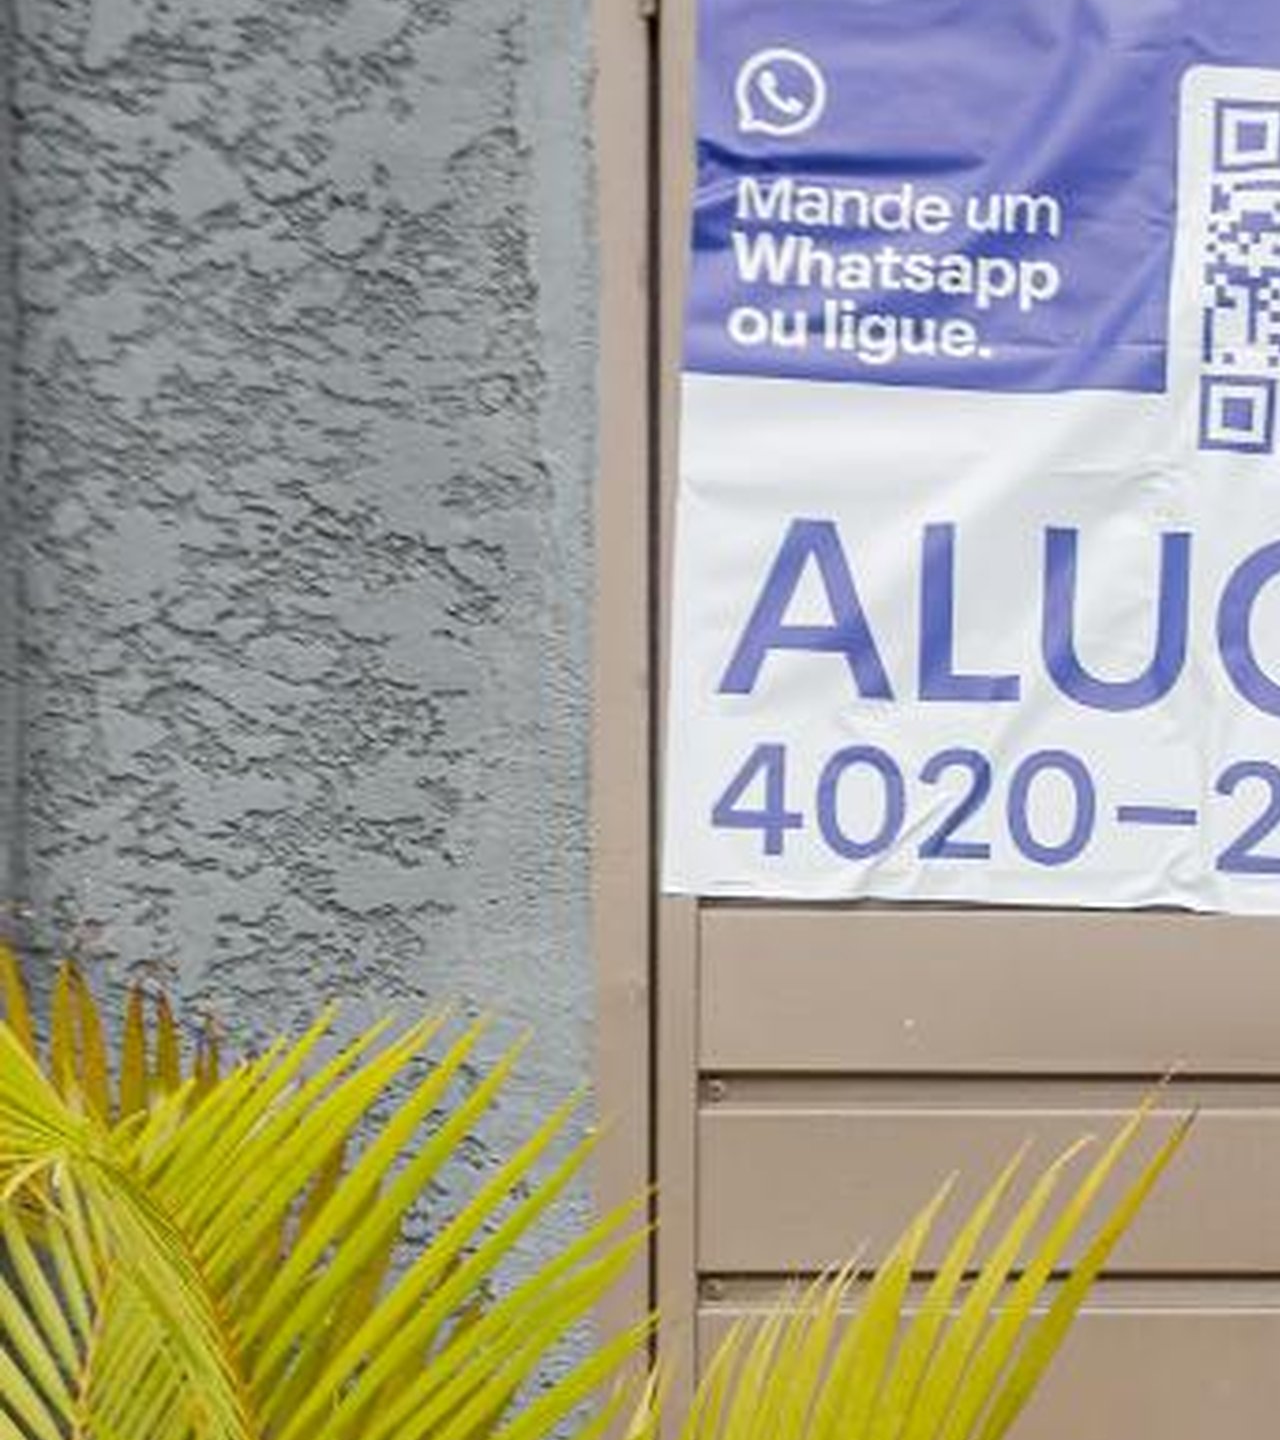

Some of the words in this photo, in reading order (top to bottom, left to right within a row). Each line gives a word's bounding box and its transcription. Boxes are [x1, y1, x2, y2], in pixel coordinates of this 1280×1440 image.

[735, 176, 954, 235] Mande
[966, 190, 1060, 237] um
[731, 234, 1060, 310] Whatsapp
[727, 302, 808, 348] ou
[823, 302, 992, 362] ligue.
